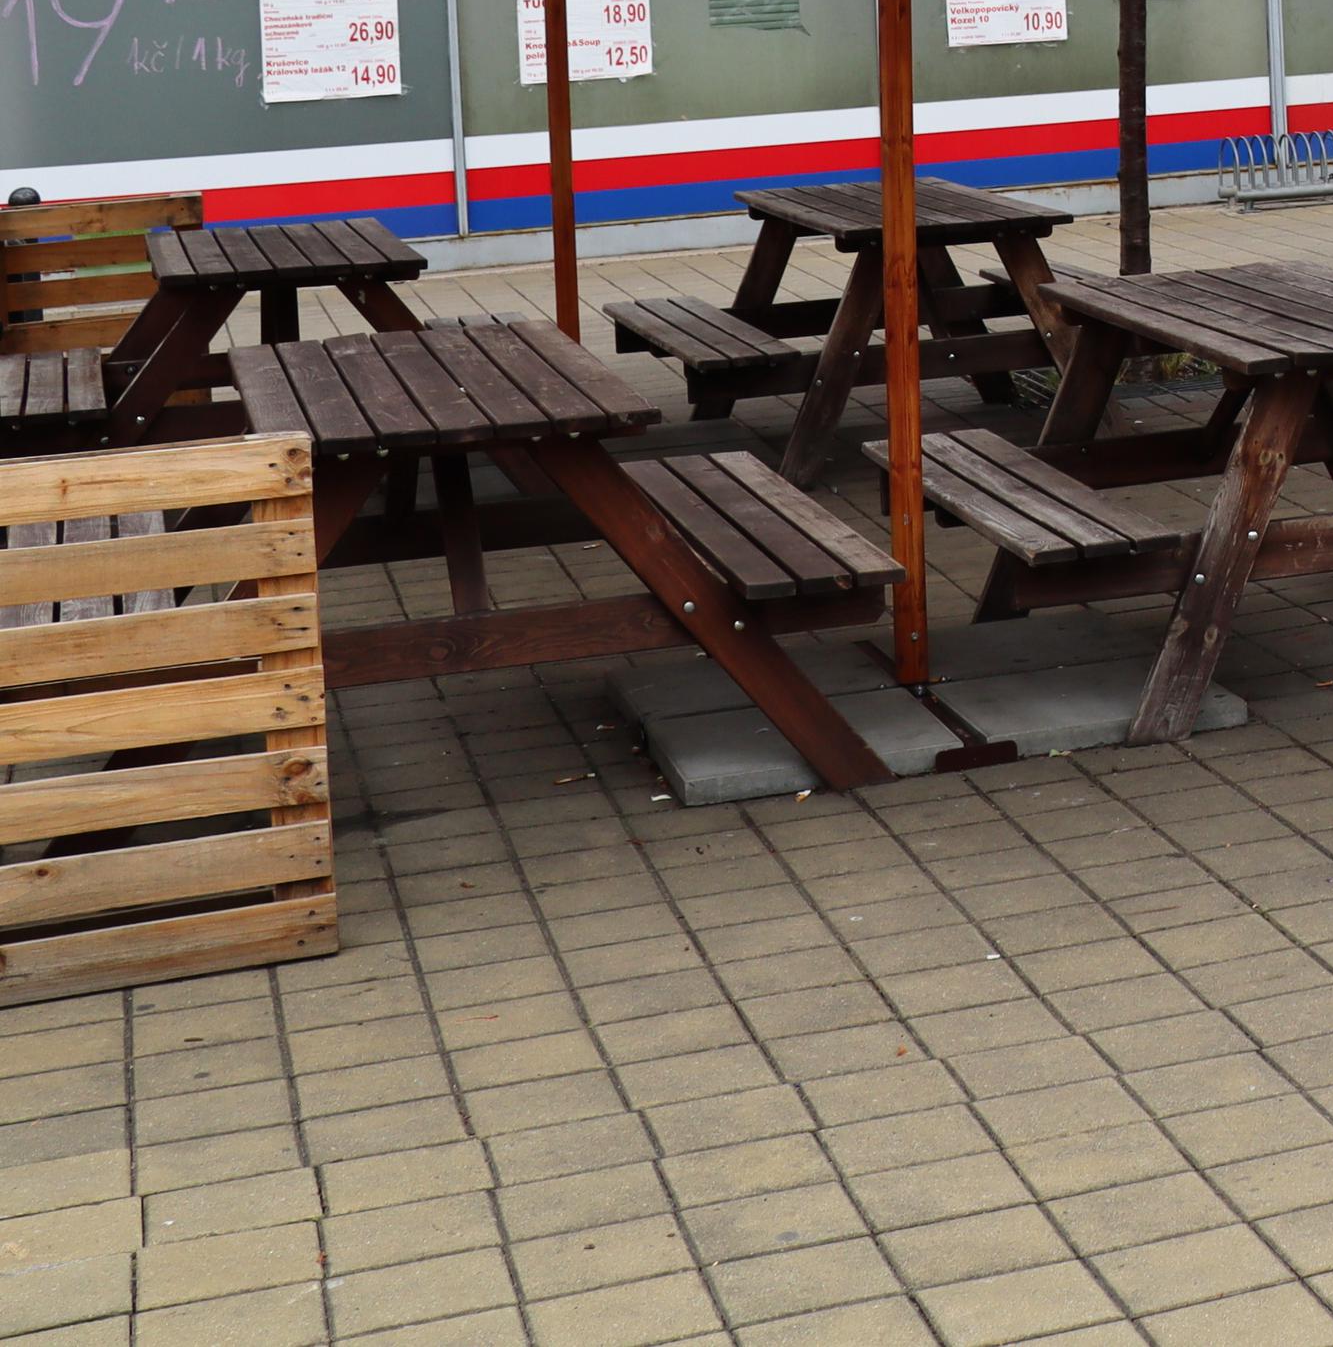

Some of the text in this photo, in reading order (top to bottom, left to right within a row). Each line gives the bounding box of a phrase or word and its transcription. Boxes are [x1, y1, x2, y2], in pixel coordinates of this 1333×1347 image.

[604, 3, 646, 26] 18,90
[950, 3, 1020, 15] Velkopopovický
[950, 15, 990, 25] Kozel 10
[349, 20, 394, 45] 26,90
[1024, 11, 1062, 33] 10,90
[606, 45, 648, 68] 12,50
[351, 64, 396, 88] 14,90
